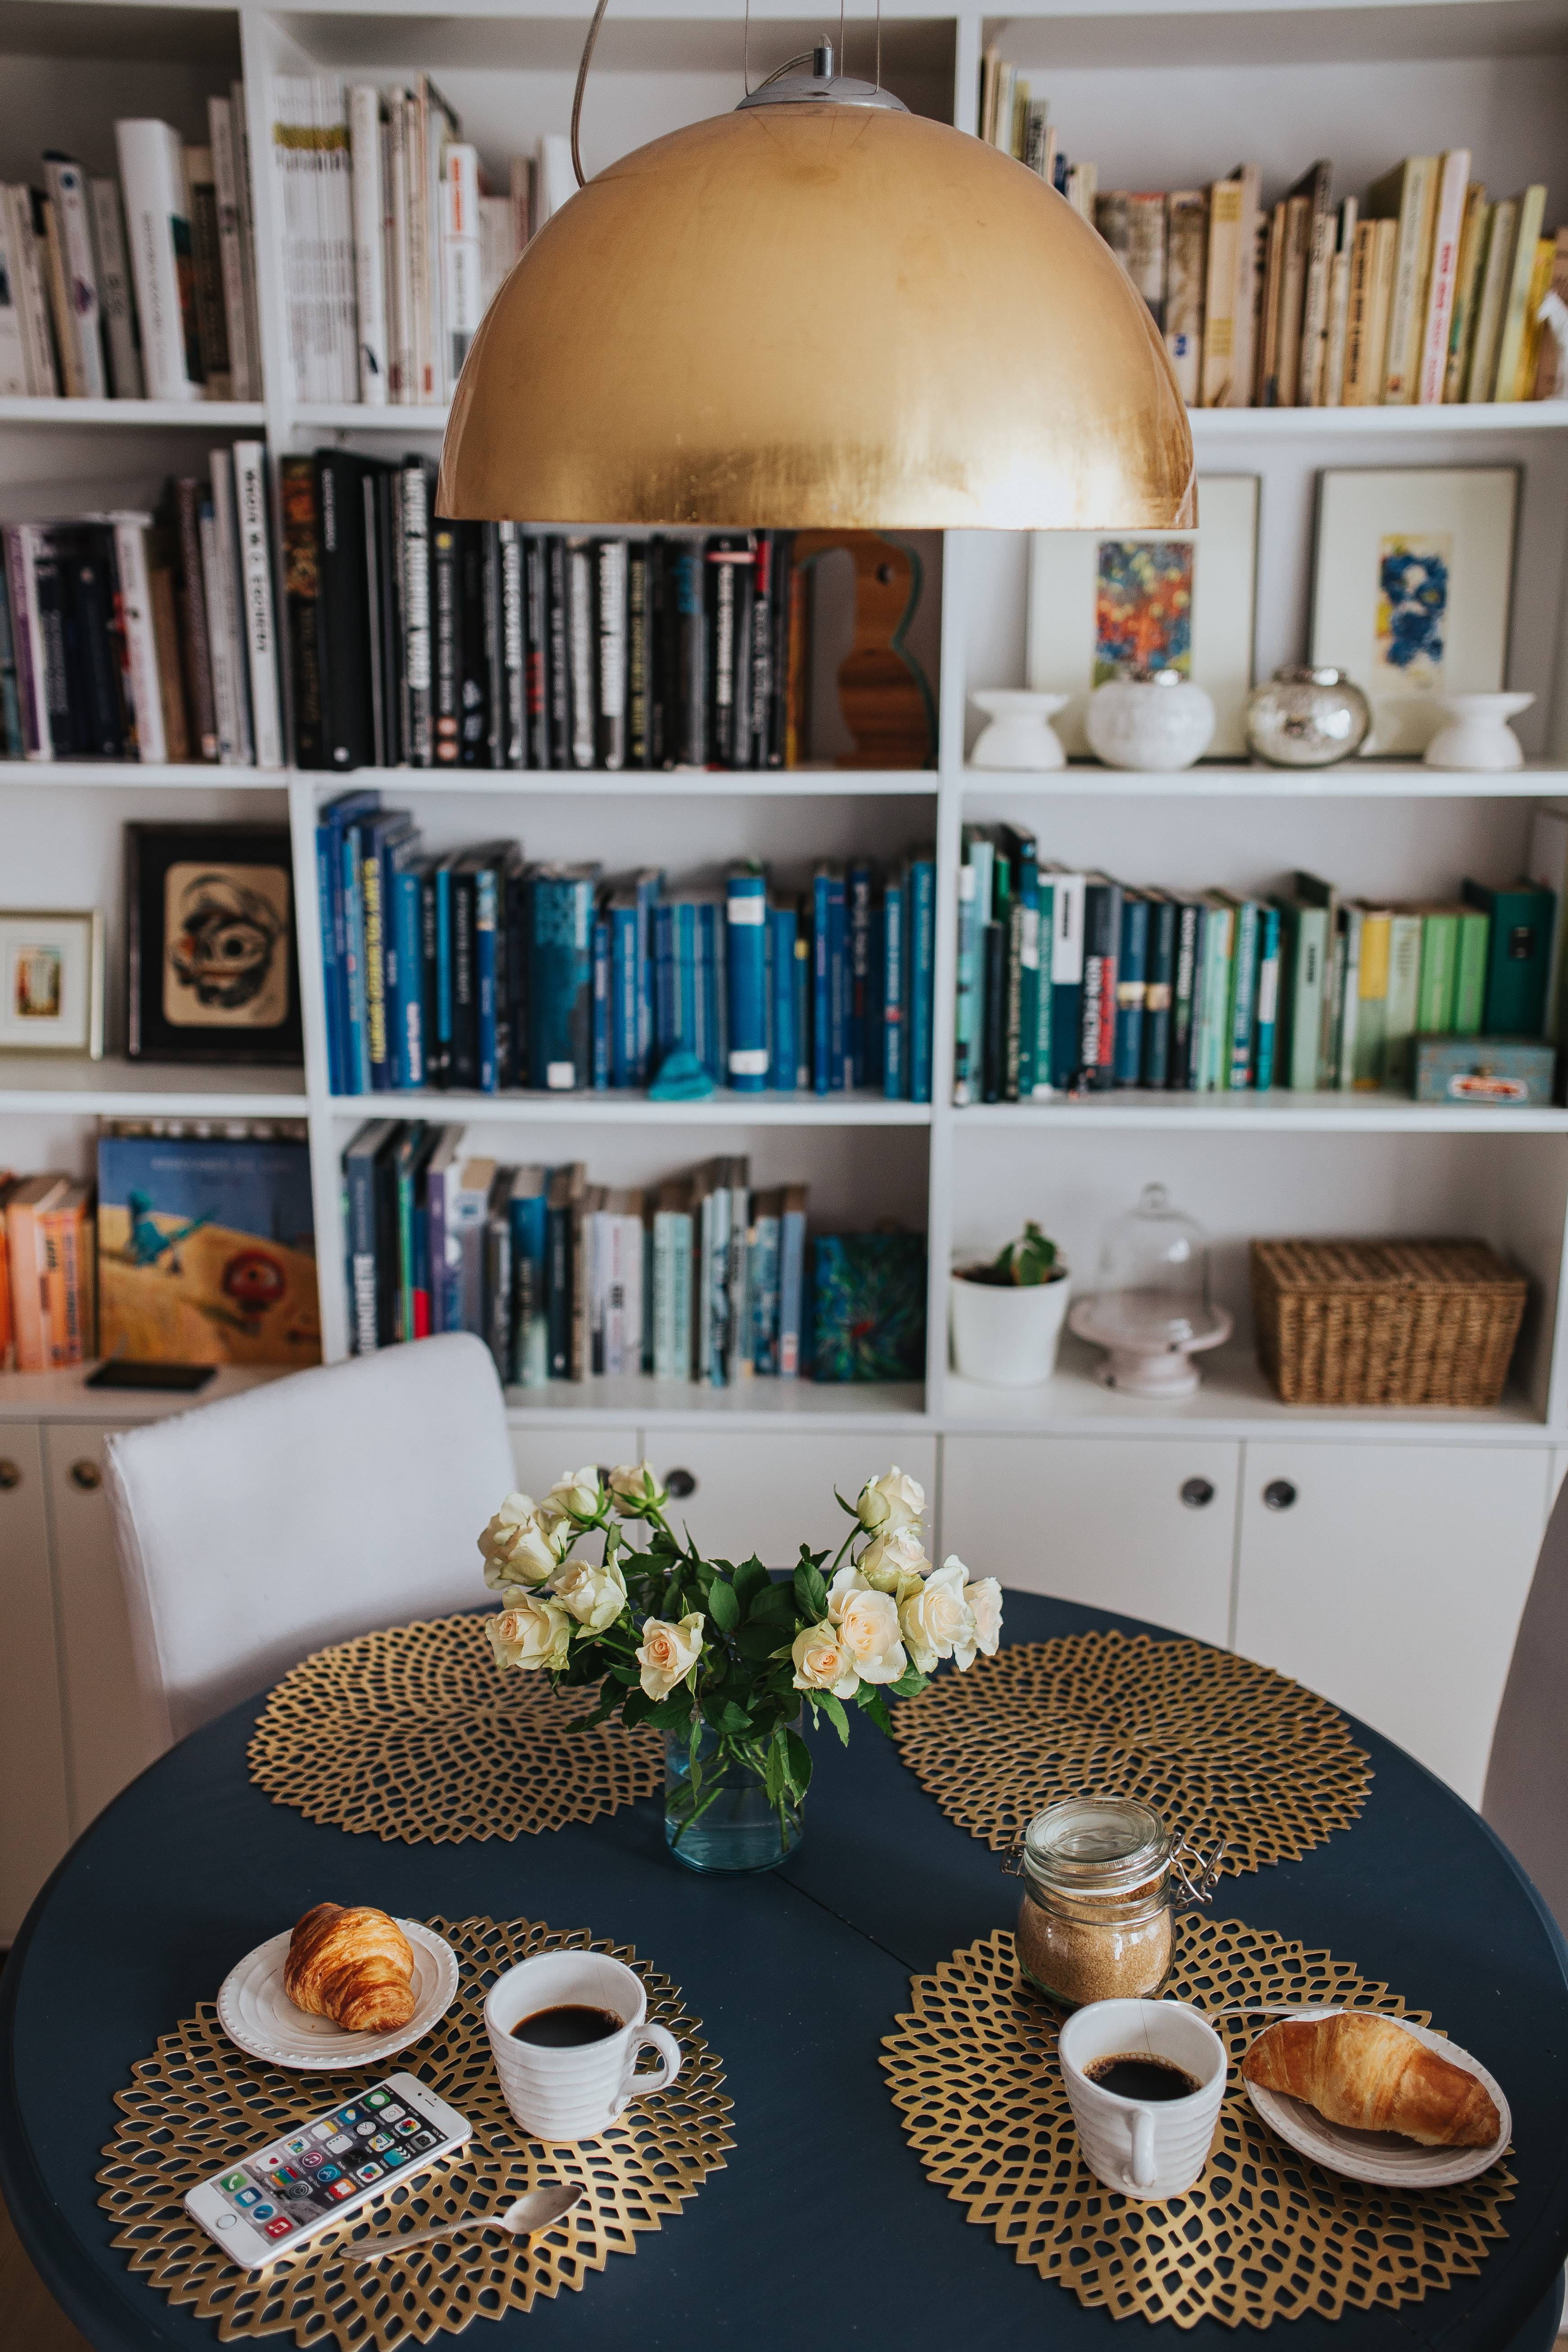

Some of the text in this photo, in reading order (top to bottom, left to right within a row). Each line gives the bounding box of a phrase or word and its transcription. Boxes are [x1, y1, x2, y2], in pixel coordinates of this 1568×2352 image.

[358, 2102, 371, 2112] Messages
[374, 2115, 385, 2125] Calendar
[319, 2146, 333, 2157] Reminders
[405, 2143, 416, 2153] Camera
[379, 2160, 389, 2168] Videos
